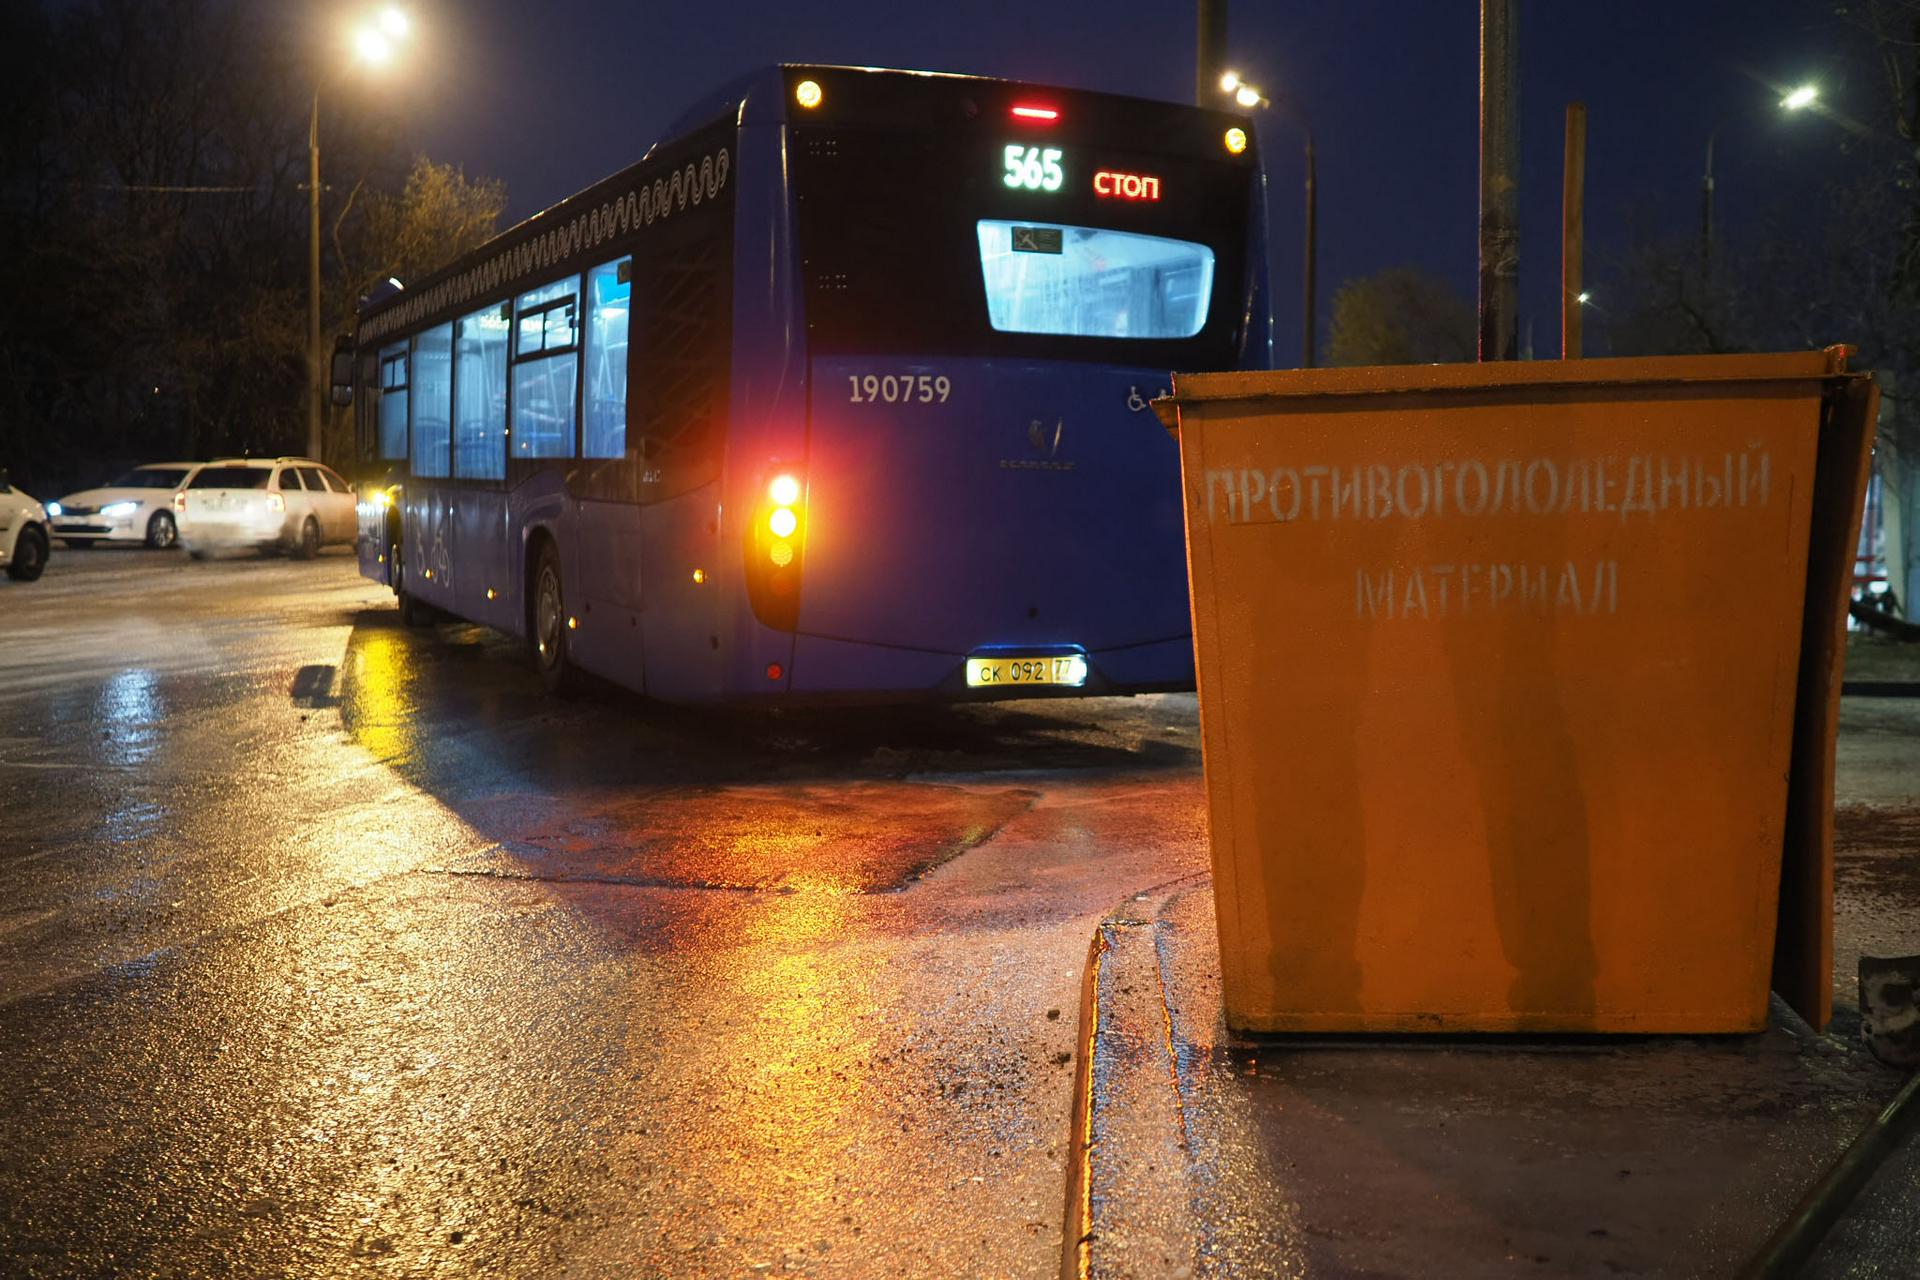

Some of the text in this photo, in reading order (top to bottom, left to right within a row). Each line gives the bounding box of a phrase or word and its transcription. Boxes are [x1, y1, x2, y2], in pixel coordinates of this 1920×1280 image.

[1003, 145, 1063, 191] 565
[1093, 171, 1160, 199] СТОП
[848, 375, 951, 404] 190759
[1205, 440, 1771, 524] ПРОТИВОГОЛОЛЕДНЫЙ
[1011, 662, 1044, 681] 092
[1055, 659, 1072, 675] 77
